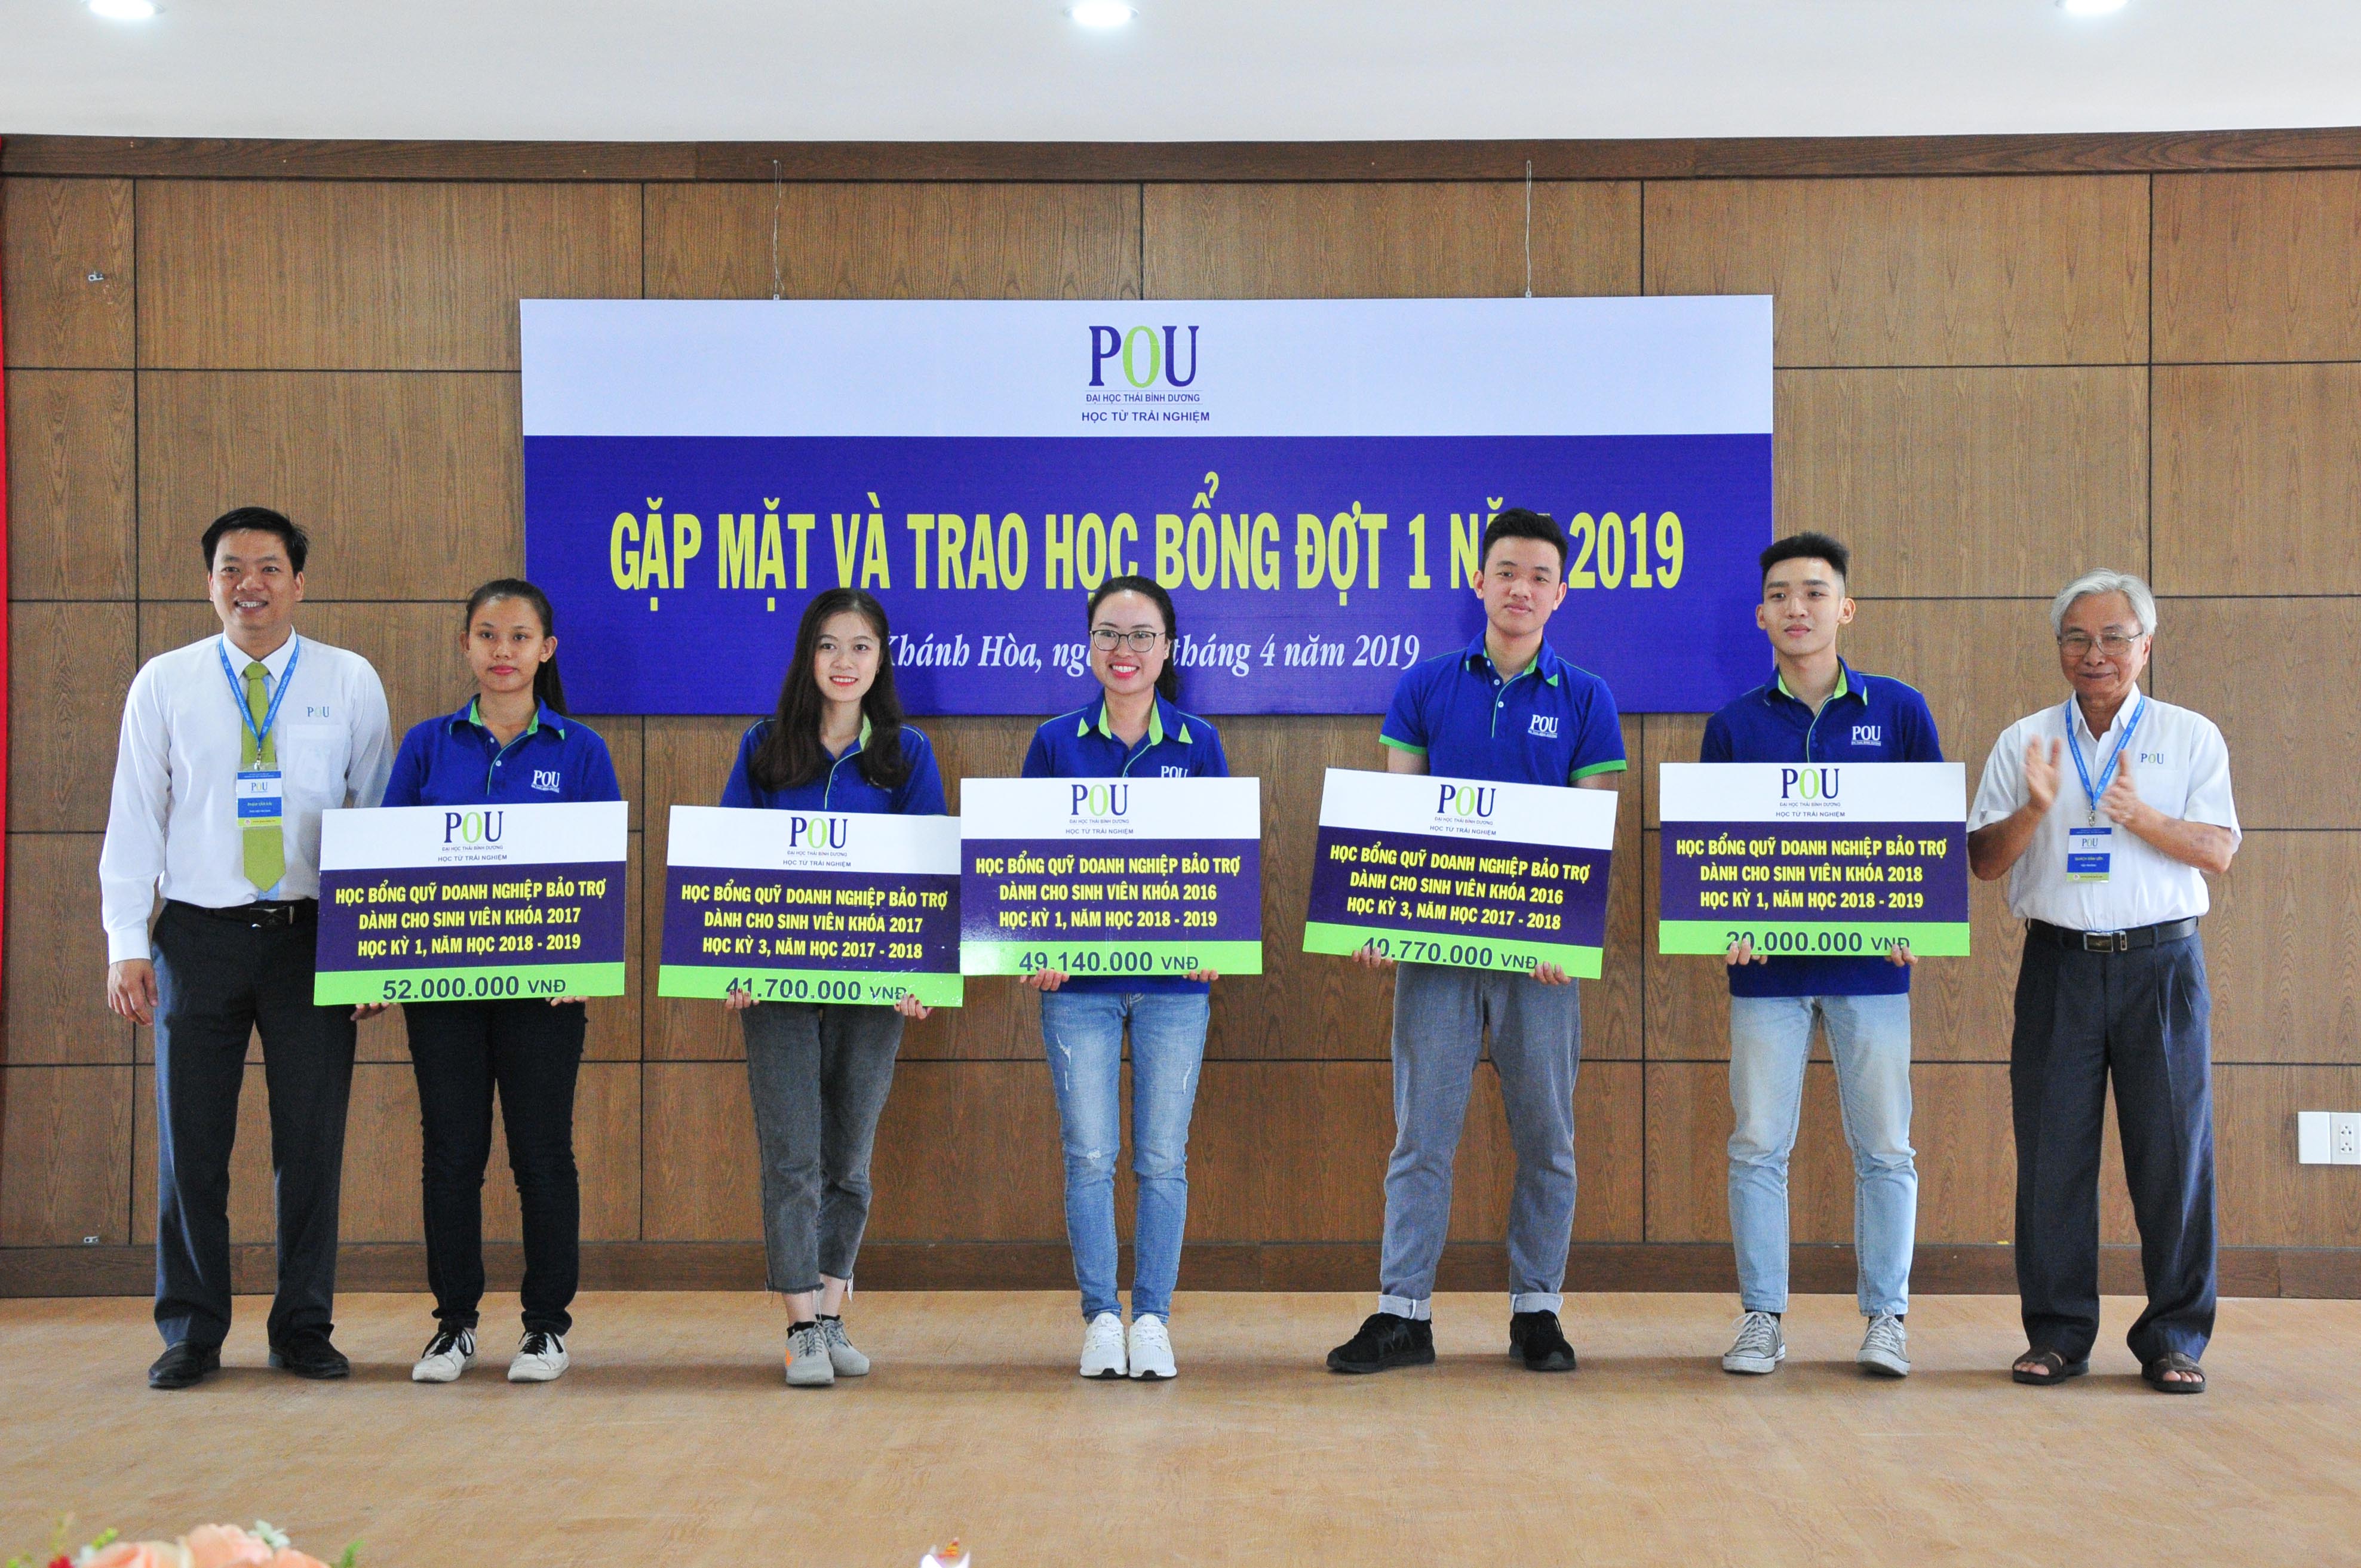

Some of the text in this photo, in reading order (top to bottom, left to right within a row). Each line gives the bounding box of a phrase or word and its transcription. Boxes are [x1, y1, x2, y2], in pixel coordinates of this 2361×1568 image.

[1089, 325, 1199, 388] POU
[1086, 392, 1200, 404] ĐẠI HỌC THÁI BÌNH DƯƠNG
[1082, 409, 1209, 423] HỌC TỪ TRẢI NGHIỆM
[610, 497, 701, 611] GẶP
[719, 498, 815, 611] MẶT
[832, 493, 890, 588] VÀ
[907, 513, 1028, 590] TRAO
[1046, 514, 1138, 602] HỌC
[1156, 472, 1279, 589] BỔNG
[1295, 502, 1387, 605] ĐỢT
[1410, 514, 1430, 588] 1
[1568, 512, 1684, 589] 2019
[978, 633, 1041, 673] Hòa,
[1173, 634, 1251, 677] tháng
[1260, 634, 1275, 666] 4
[1284, 634, 1344, 666] năm
[1352, 634, 1419, 670] 2019
[307, 706, 330, 717] POU
[1530, 714, 1559, 733] POU
[1852, 725, 1881, 740] POU
[2141, 753, 2164, 764] POU
[533, 770, 560, 788] POU
[1782, 769, 1838, 798] POU
[1071, 785, 1127, 814] POU
[1438, 785, 1495, 816] POU
[444, 811, 502, 842] POU
[790, 817, 846, 847] POU
[1676, 832, 1946, 859] HỌC BỔNG QUỸ DOANH NGHIỆP BẢO TRỢ
[976, 850, 1241, 877] HỌC BỔNG QUỸ DOANH NGHIỆP BẢO TRỢ
[1330, 841, 1591, 884] HỌC BỔNG QUỸ DOANH NGHIỆP BẢO TRỢ
[1700, 862, 1923, 881] DÀNH CHO SINH VIÊN KHÓA 2018
[335, 875, 606, 906] HỌC BỔNG QUỸ DOANH NGHIỆP BẢO TRỢ
[681, 878, 948, 910] HỌC BỔNG QUỸ DOANH NGHIỆP BẢO TRỢ
[999, 880, 1217, 900] DÀNH CHO SINH VIÊN KHÓA 2016
[1350, 869, 1563, 904] DÀNH CHO SINH VIÊN KHÓA 2016
[1700, 888, 1923, 910] HỌC KỲ 1, NĂM HỌC 2018 2019
[359, 905, 581, 929] DÀNH CHO SINH VIÊN KHÓA 2017
[704, 908, 923, 933] DÀNH CHO SINH VIÊN KHÓA 2017
[999, 907, 1217, 930] HỌC KỲ 1, NĂM HỌC 2018 2019
[1347, 896, 1561, 930] HỌC KỲ 3, NĂM HỌC 2017 2018
[358, 933, 581, 959] HỌC KỲ 1, NĂM HỌC 2018 2019
[702, 934, 922, 959] HỌC KỲ 3, NĂM HỌC 2017 2018
[1160, 957, 1198, 970] VNĐ
[383, 976, 565, 1000] 52.000.000 VNĐ
